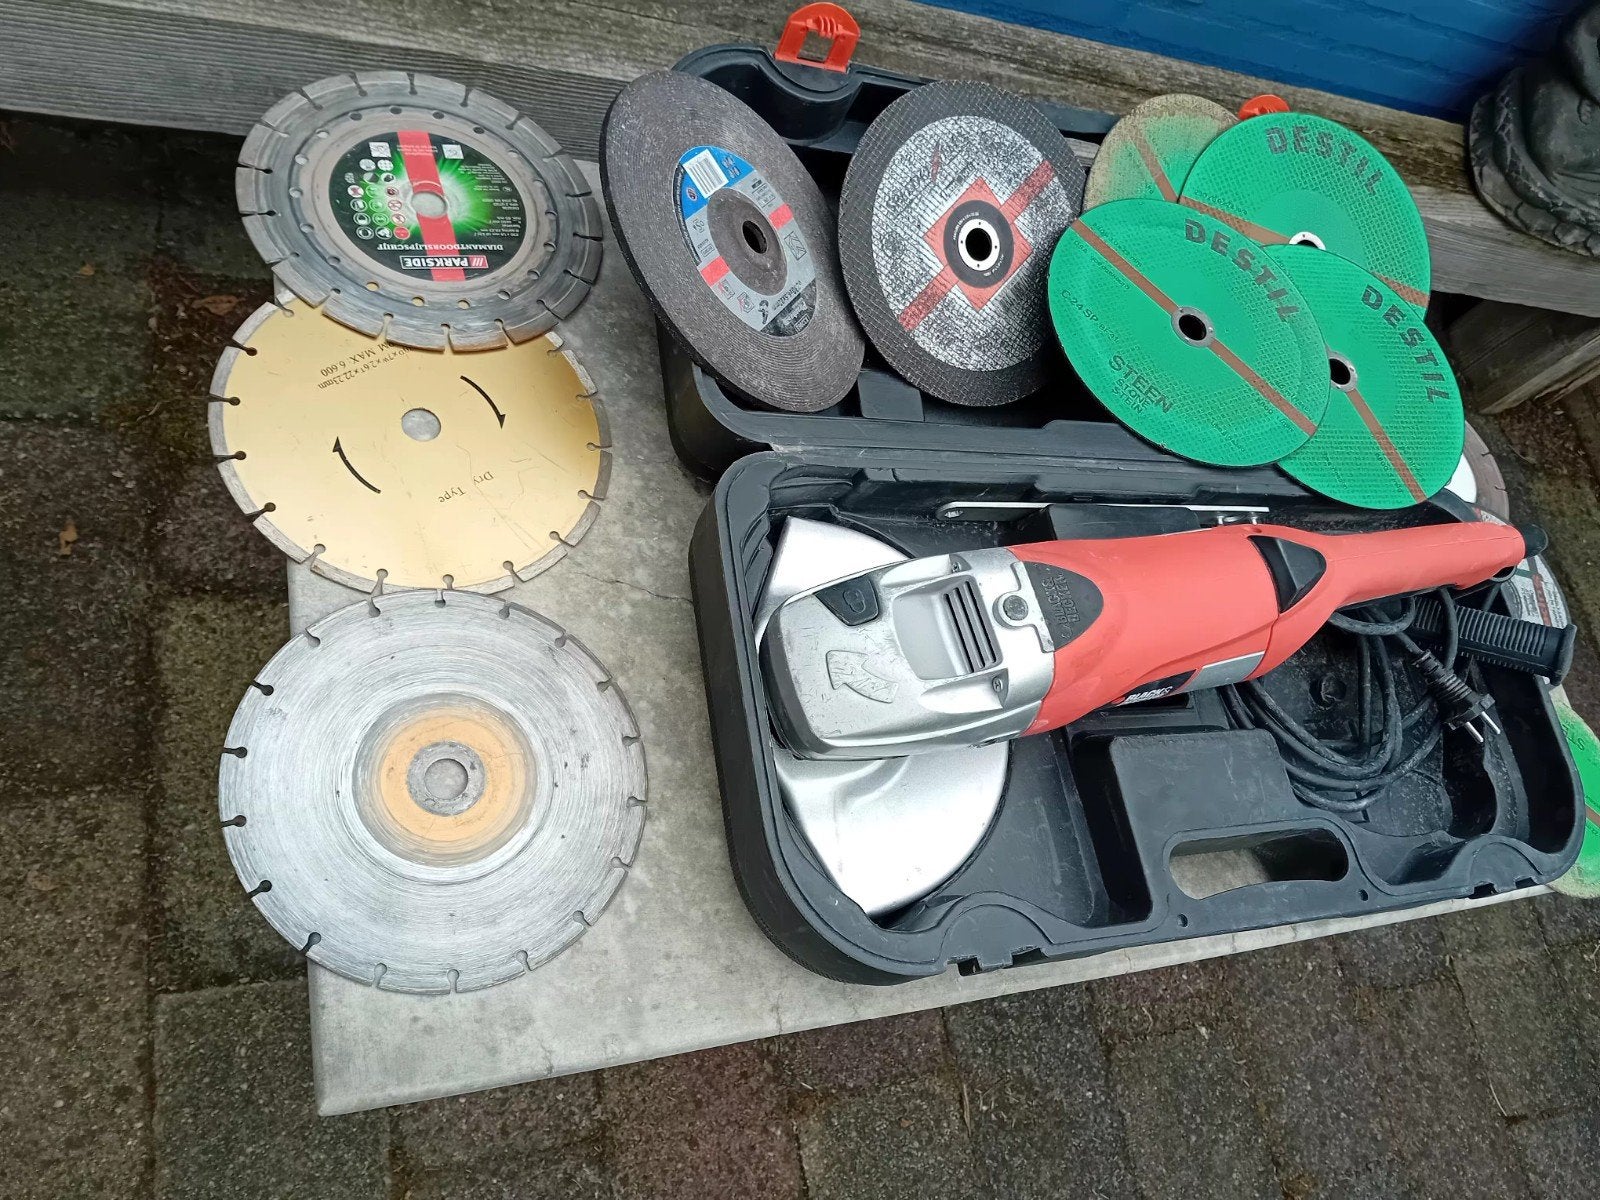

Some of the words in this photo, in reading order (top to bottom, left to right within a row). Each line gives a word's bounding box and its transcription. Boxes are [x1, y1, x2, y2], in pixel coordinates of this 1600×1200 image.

[1265, 126, 1386, 198] DESTIL
[377, 243, 504, 251] DIAMANTDOORSLIJPSCHIJF
[404, 257, 468, 267] PARKSIDE
[1184, 218, 1301, 323] DESTIL
[350, 348, 375, 364] MAX
[1361, 284, 1450, 403] DESTIL
[1108, 353, 1174, 414] STEEN
[1115, 379, 1151, 409] STONE
[1111, 386, 1144, 415] STEIN
[473, 471, 494, 485] Dry
[438, 486, 466, 505] Type
